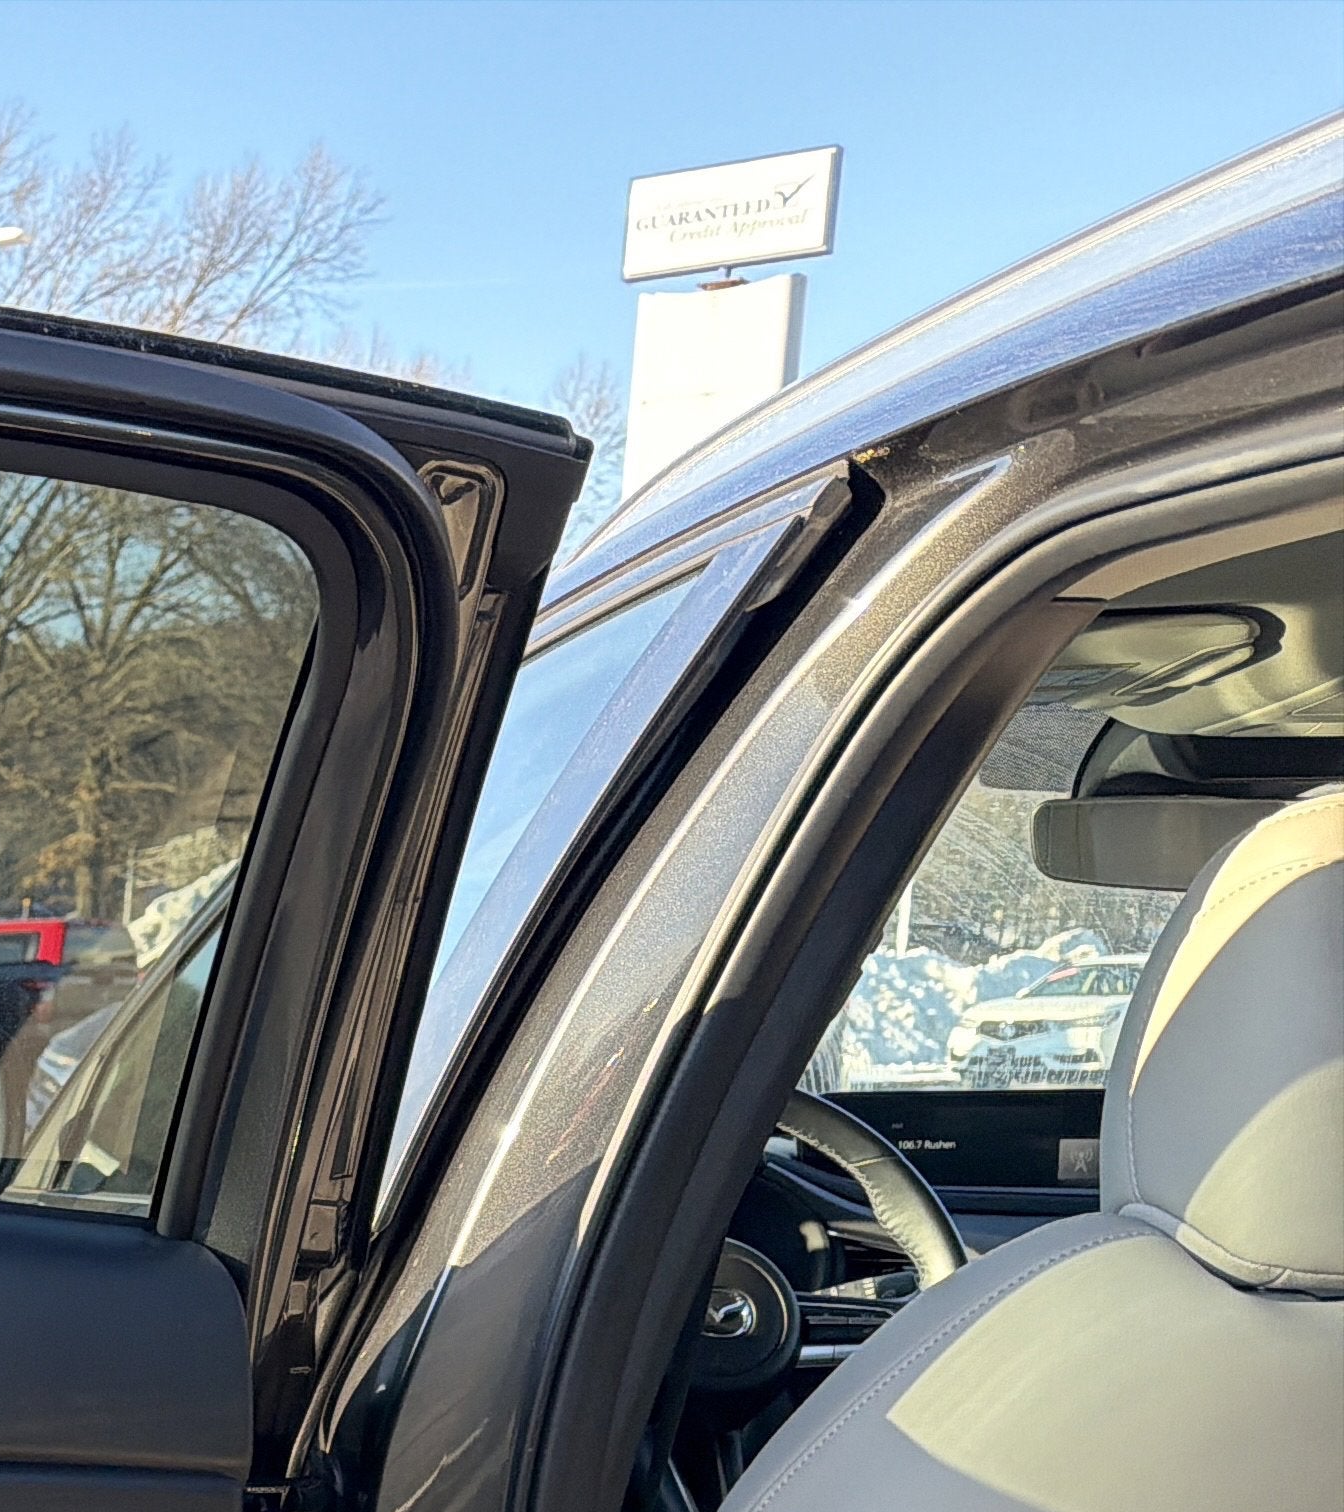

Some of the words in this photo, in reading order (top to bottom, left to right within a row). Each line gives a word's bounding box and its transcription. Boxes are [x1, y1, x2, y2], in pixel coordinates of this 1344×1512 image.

[636, 199, 771, 231] GUARANTEED
[670, 225, 721, 242] Credit
[731, 208, 809, 237] Approval
